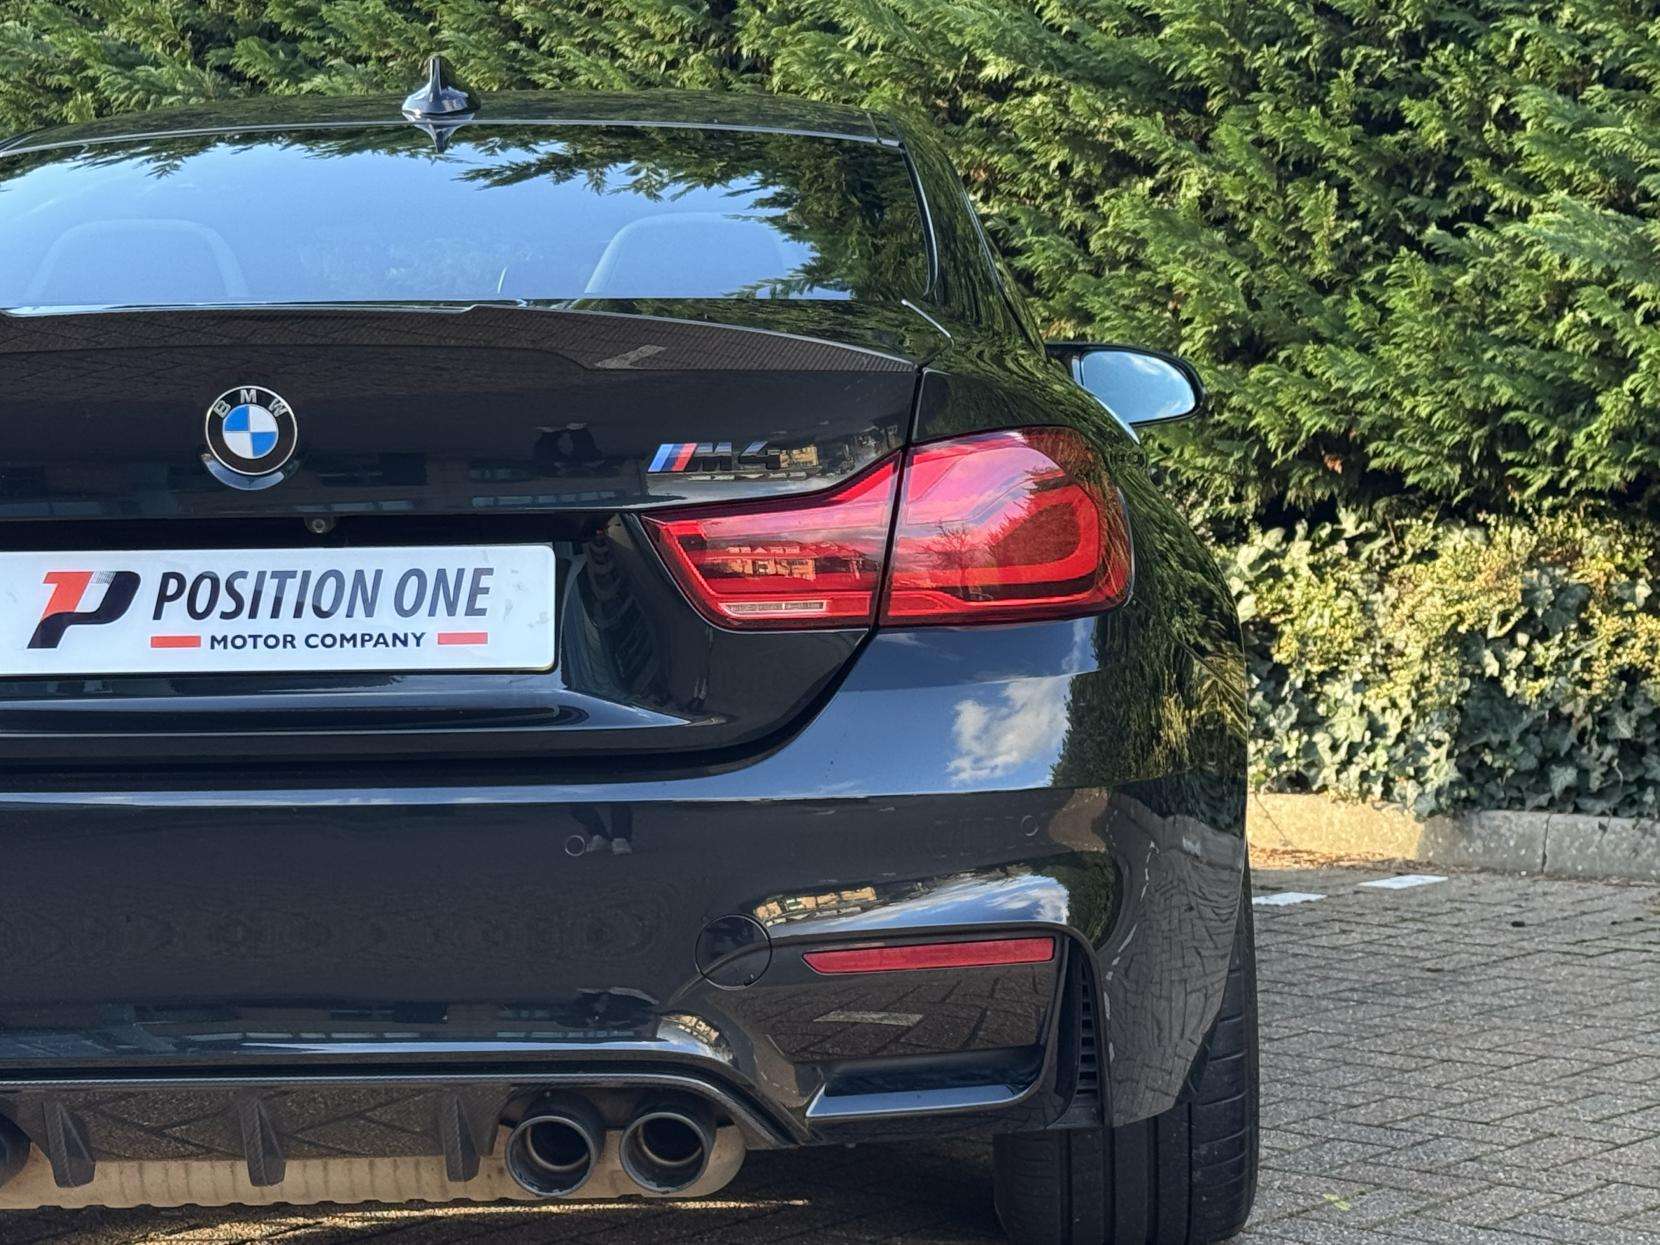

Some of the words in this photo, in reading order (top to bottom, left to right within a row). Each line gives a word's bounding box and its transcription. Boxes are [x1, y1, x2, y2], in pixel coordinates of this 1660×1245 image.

[213, 389, 289, 418] BMW
[684, 440, 781, 471] M4
[153, 569, 383, 621] POSITION
[394, 567, 494, 618] ONE
[210, 634, 297, 650] MOTOR
[304, 632, 426, 649] COMPANY
